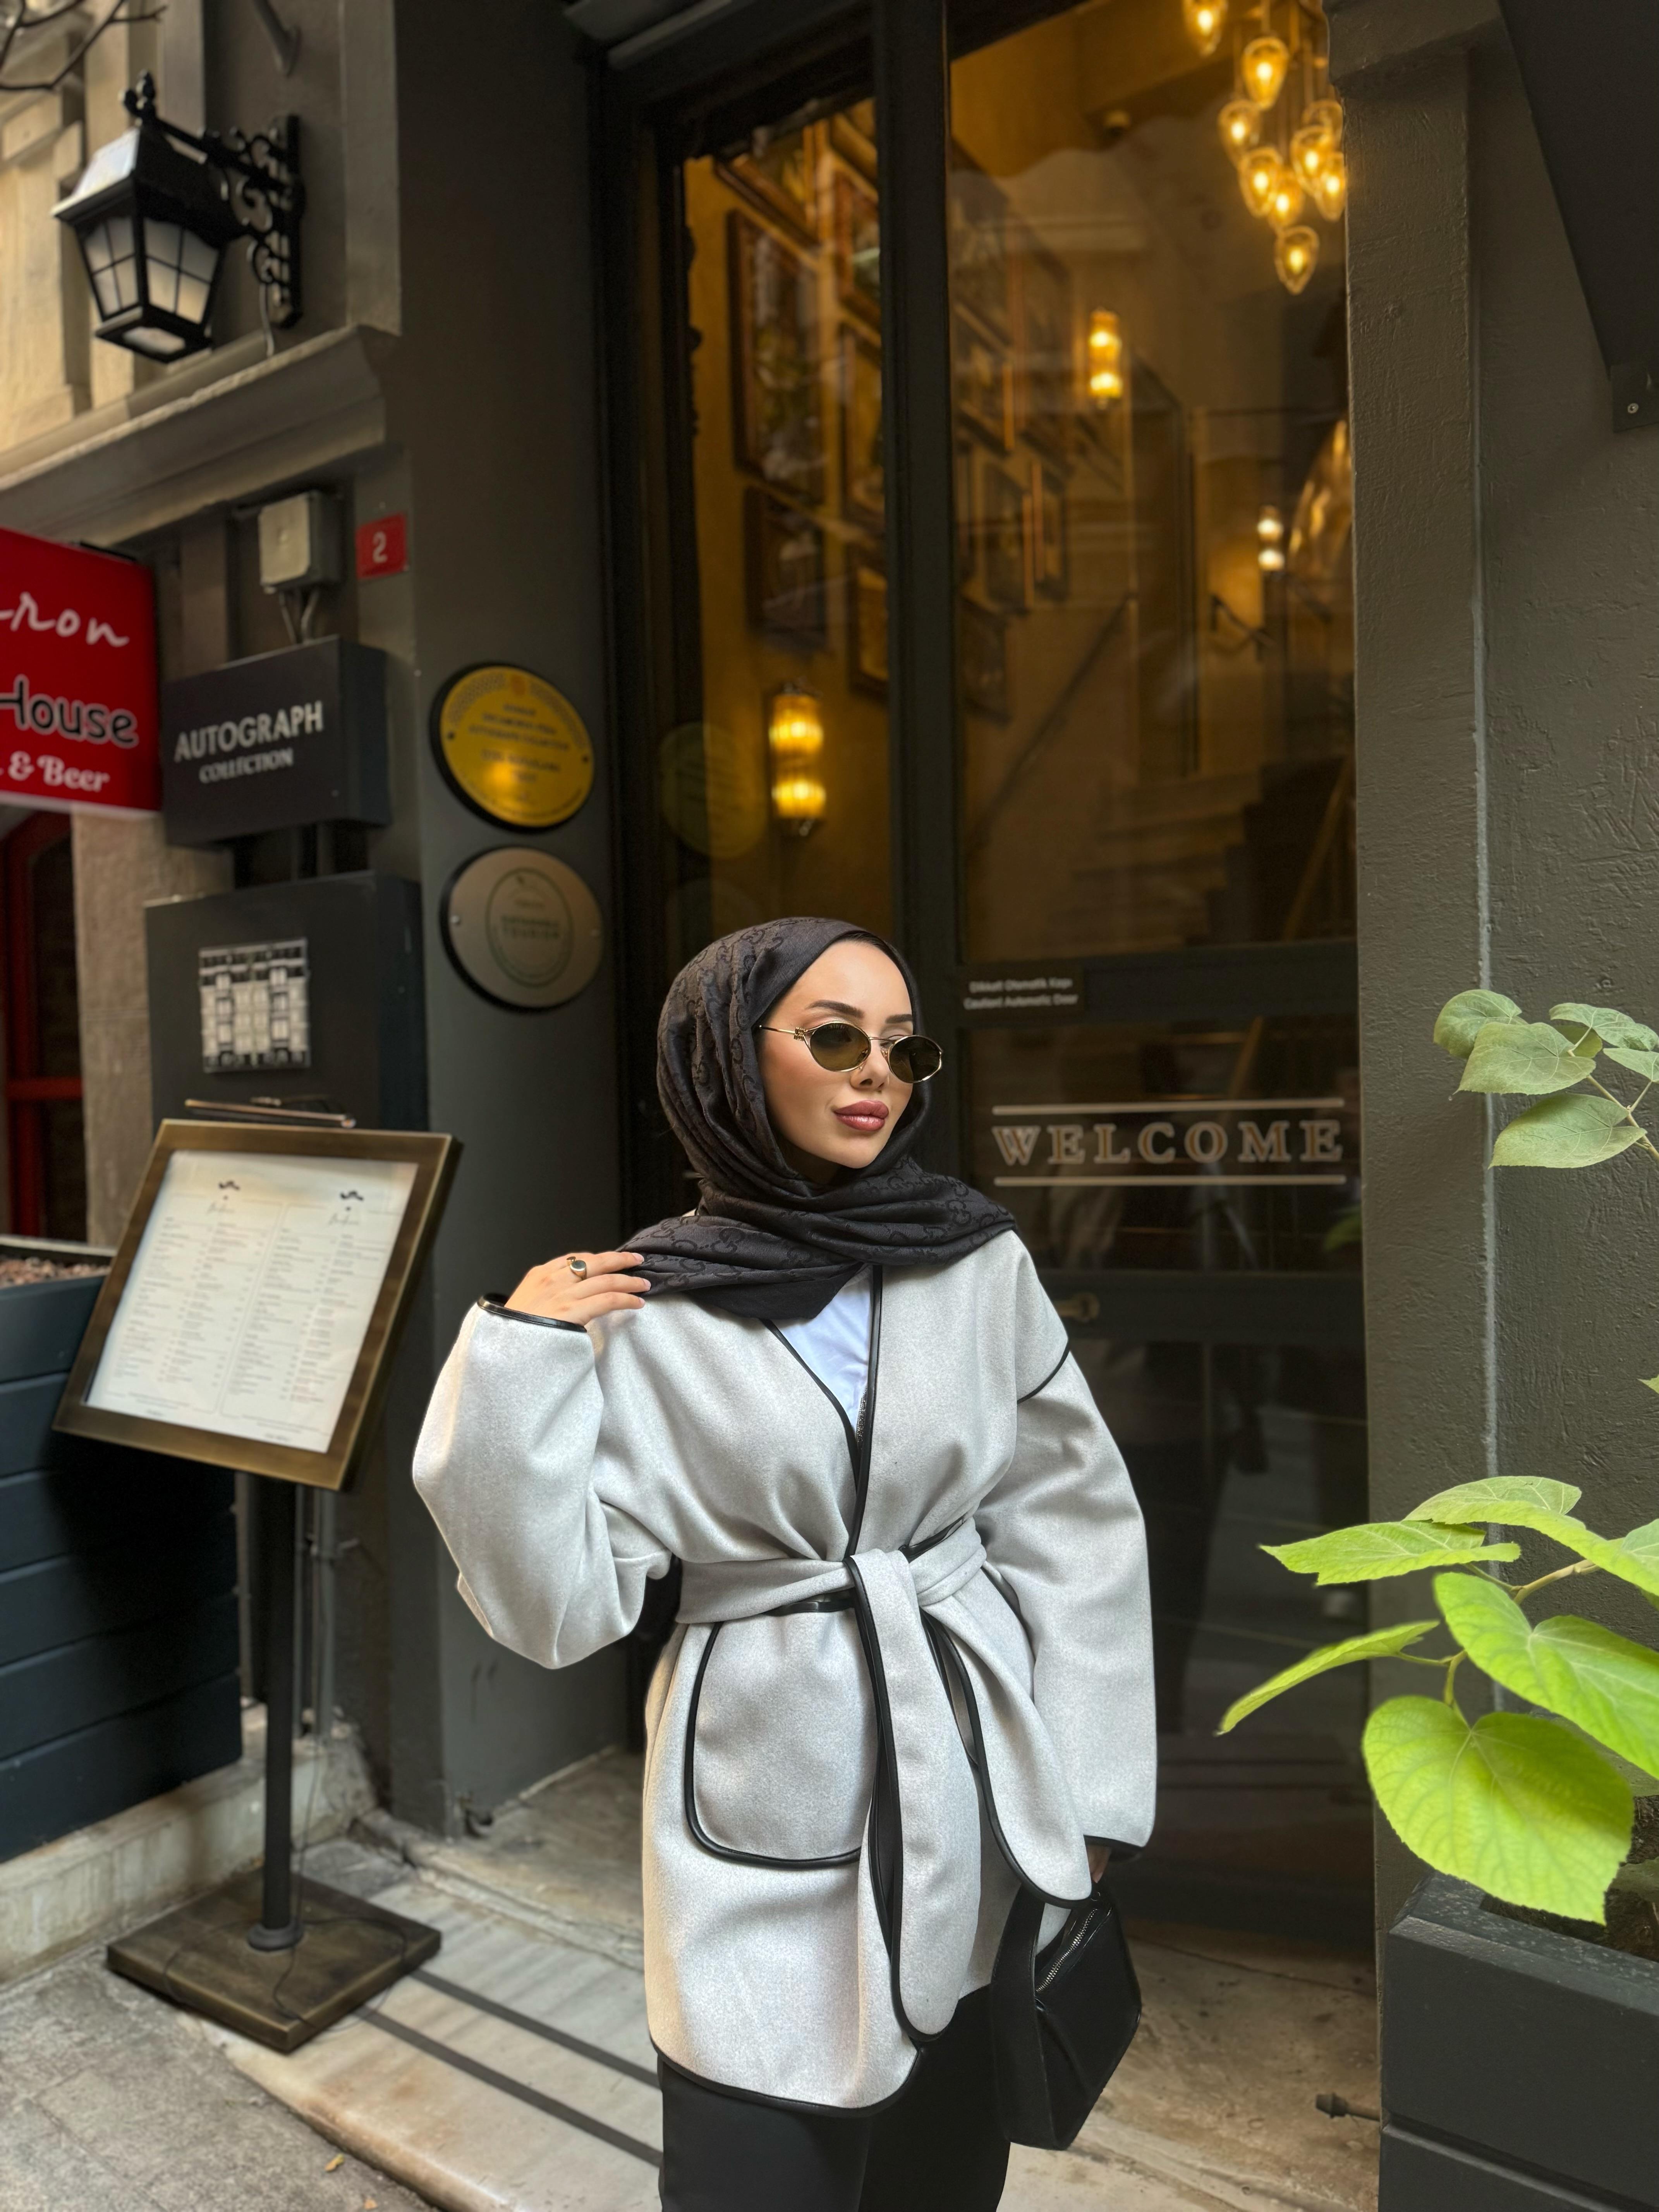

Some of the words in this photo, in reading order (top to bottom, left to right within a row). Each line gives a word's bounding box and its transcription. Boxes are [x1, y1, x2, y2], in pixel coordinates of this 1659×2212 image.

[372, 531, 388, 563] 2
[173, 700, 323, 763] AUTOGRAPH
[8, 750, 35, 781] &
[37, 754, 110, 792] Beer
[199, 747, 294, 783] COLLECTION
[992, 1119, 1343, 1166] WELCOME
